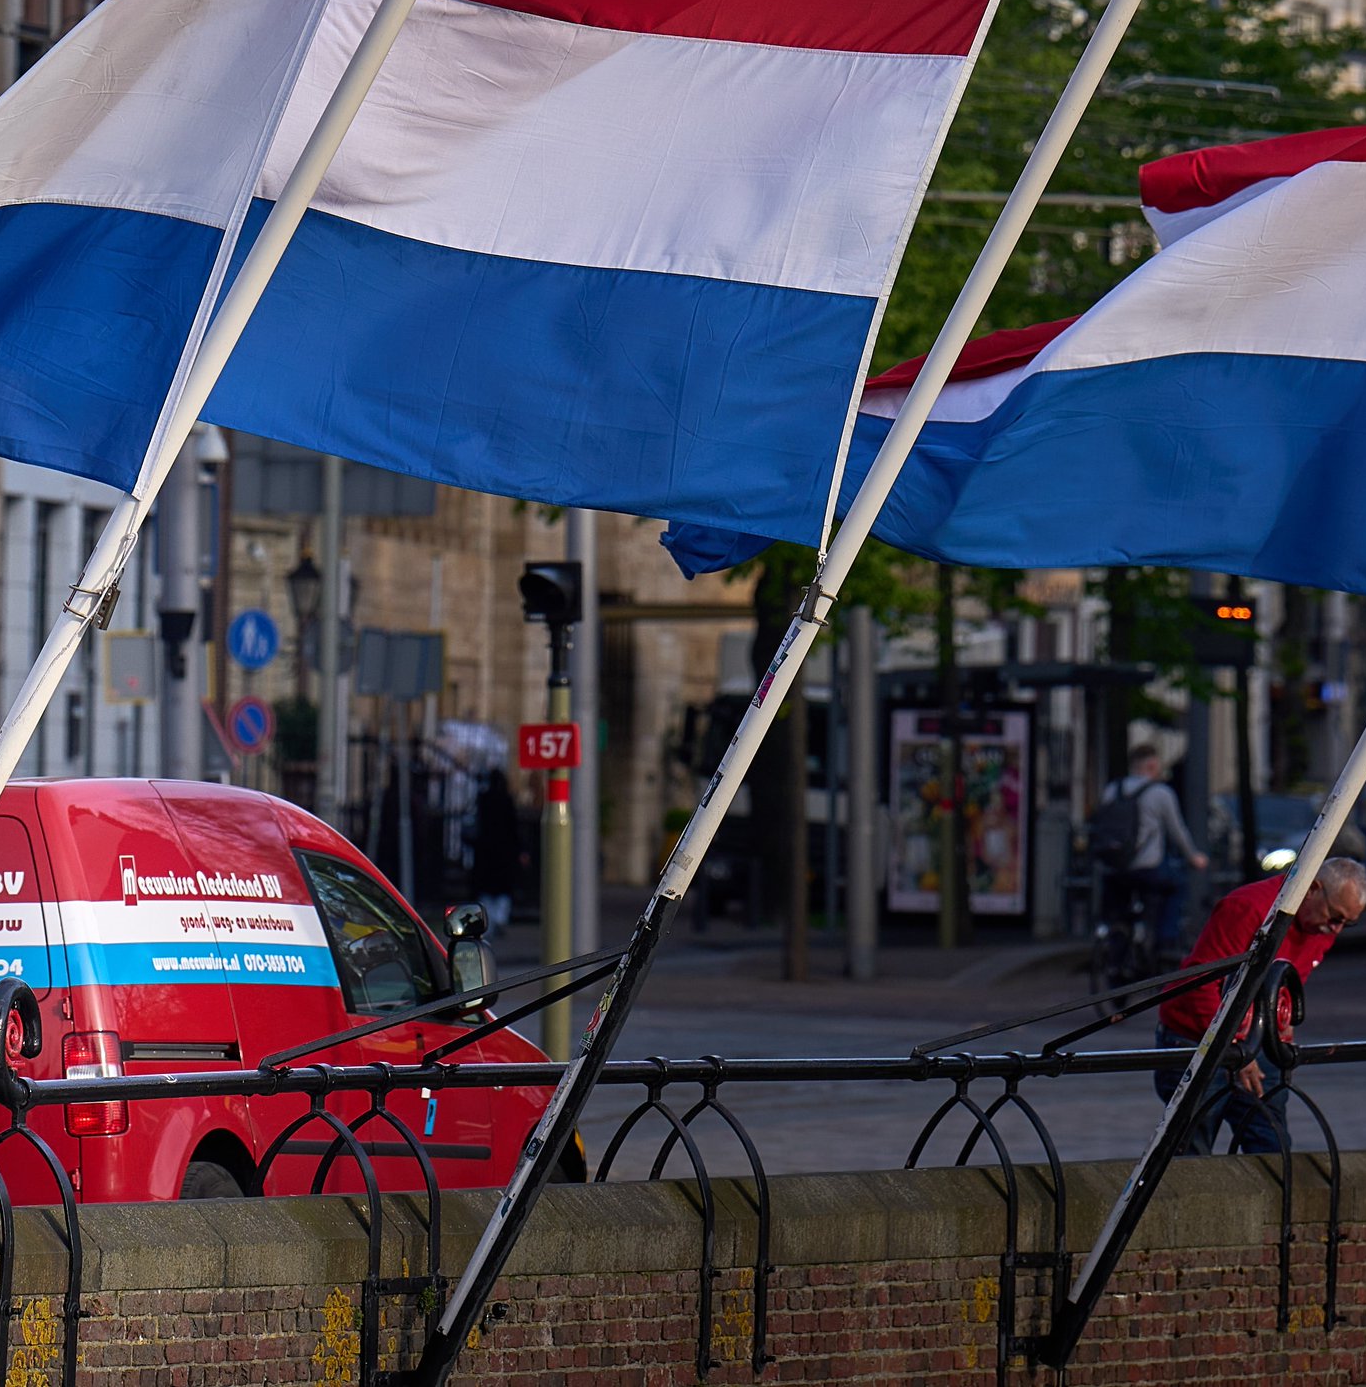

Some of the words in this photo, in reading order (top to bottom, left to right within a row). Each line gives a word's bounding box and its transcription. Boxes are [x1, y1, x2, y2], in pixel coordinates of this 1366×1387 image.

[526, 736, 536, 757] 1
[539, 731, 573, 761] 57
[197, 870, 263, 899] Nederland
[261, 873, 283, 899] BV
[180, 912, 210, 934] grond,
[247, 914, 294, 931] waterbouw
[243, 953, 286, 973] 070-3838
[286, 955, 306, 973] 704
